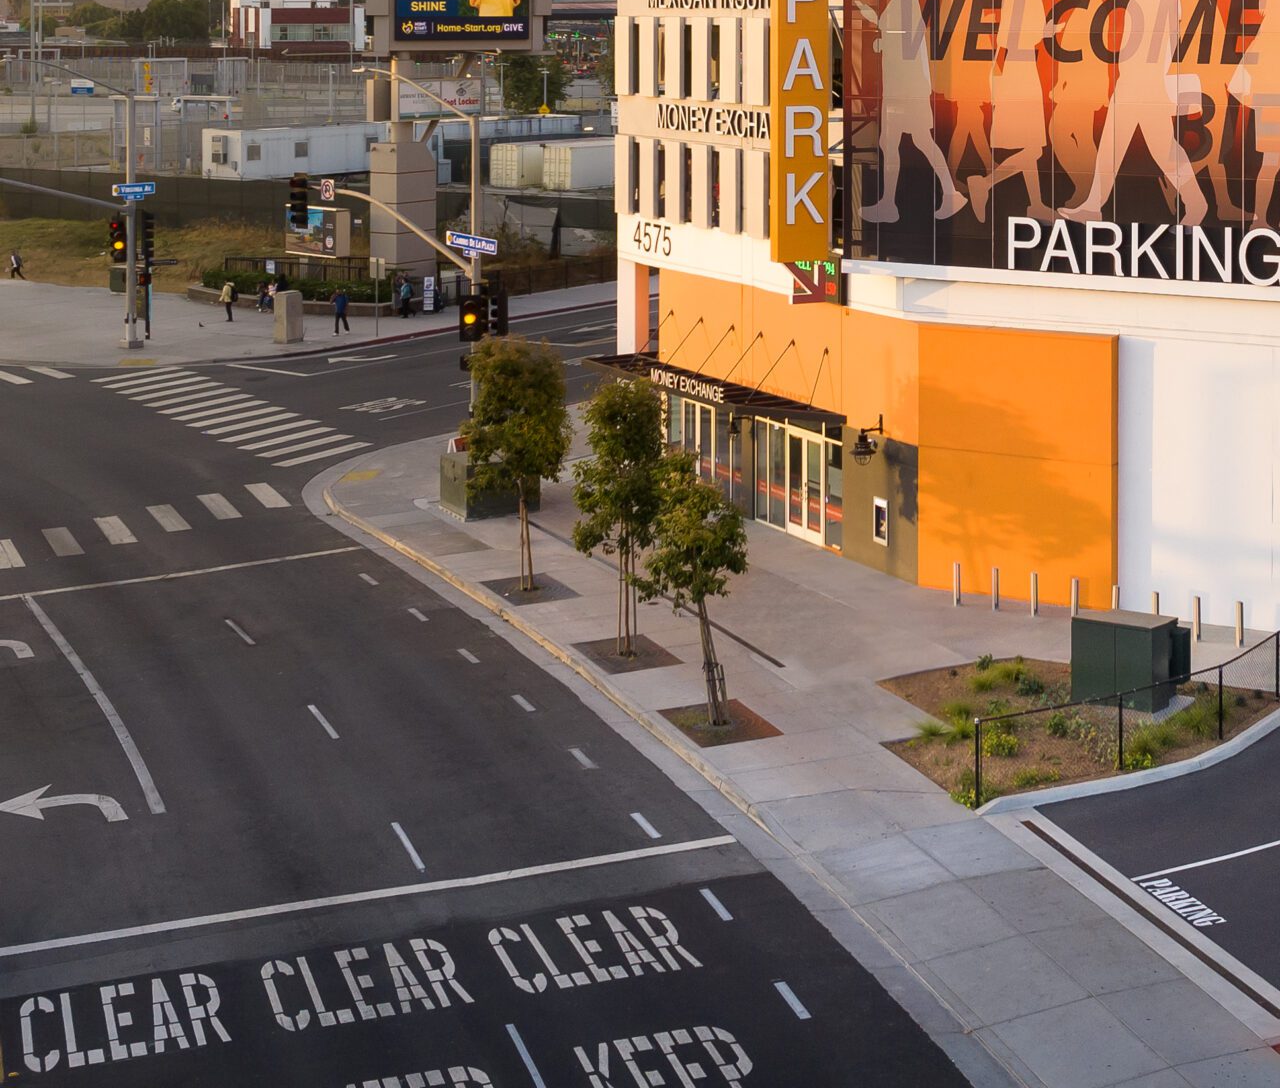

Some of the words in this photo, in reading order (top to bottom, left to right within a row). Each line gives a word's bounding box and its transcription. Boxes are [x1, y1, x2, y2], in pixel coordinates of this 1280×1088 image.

[410, 1, 447, 12] SHINE
[437, 22, 524, 34] Home-Start.org/GIVE
[458, 97, 479, 105] Locker
[656, 103, 714, 133] MONEY
[715, 109, 770, 140] EXCHA
[633, 221, 672, 256] 4575
[650, 367, 679, 389] MONEY
[680, 376, 724, 404] EXCHANGE
[1139, 878, 1227, 927] PARKING
[488, 906, 703, 993] CLEAR
[260, 938, 475, 1031] CLEAR
[20, 973, 232, 1072] CLEAR
